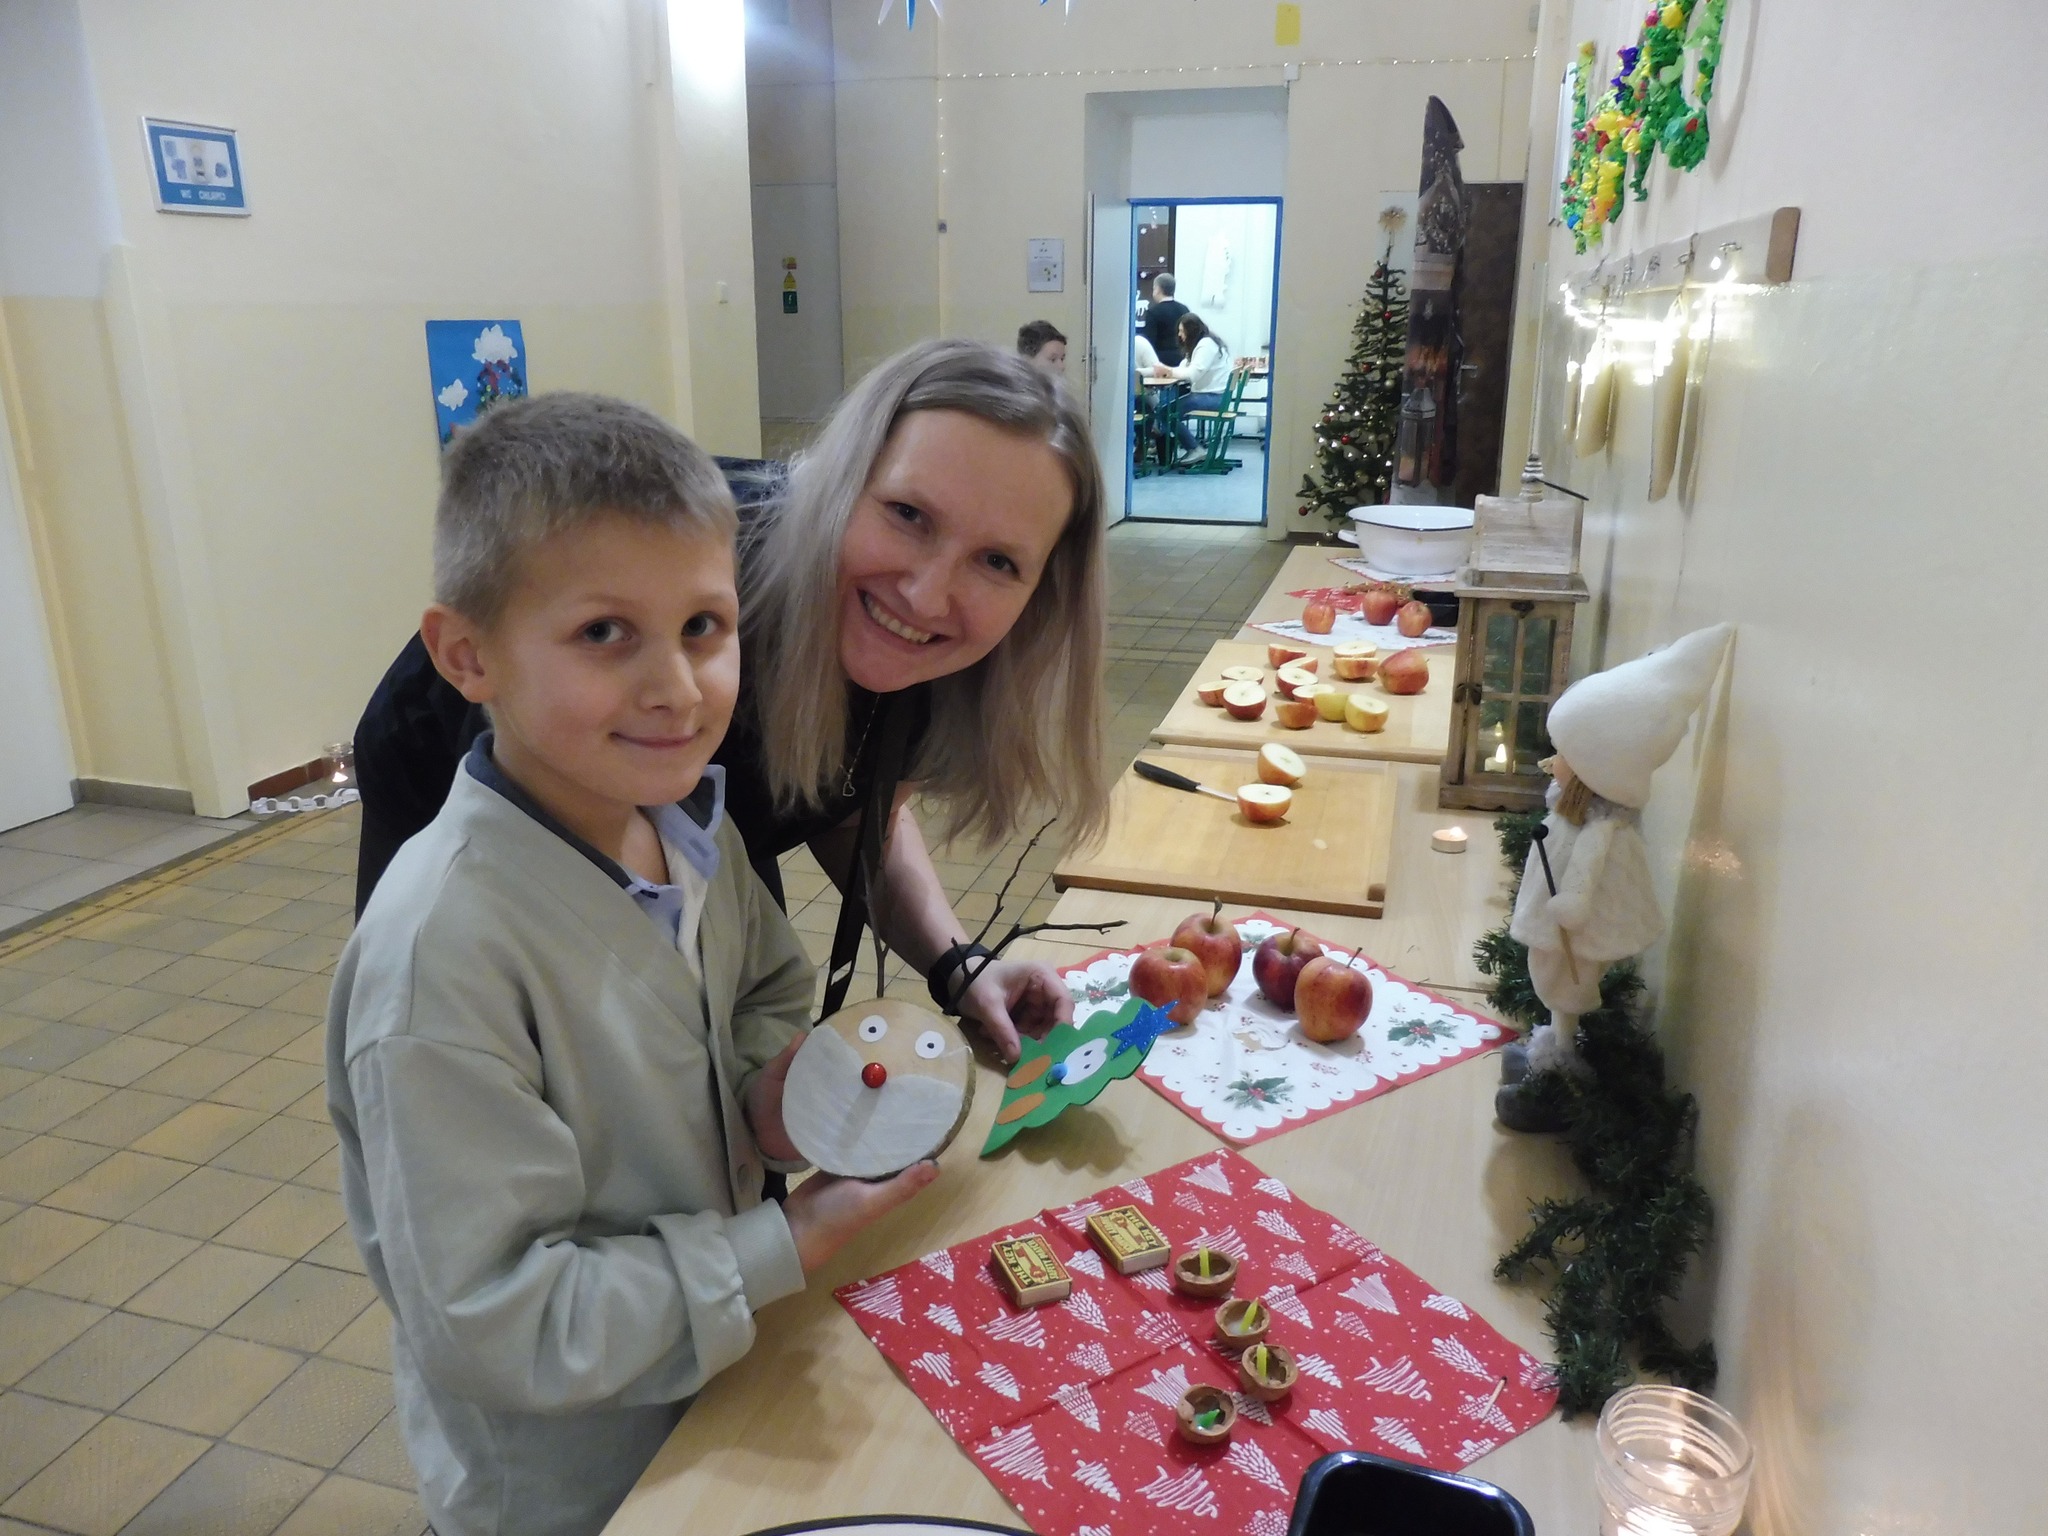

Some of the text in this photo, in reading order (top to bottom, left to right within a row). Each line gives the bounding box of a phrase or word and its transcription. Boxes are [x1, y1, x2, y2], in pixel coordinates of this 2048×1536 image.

[1124, 1210, 1158, 1245] THE KEY
[1000, 1244, 1032, 1285] THE KEY
